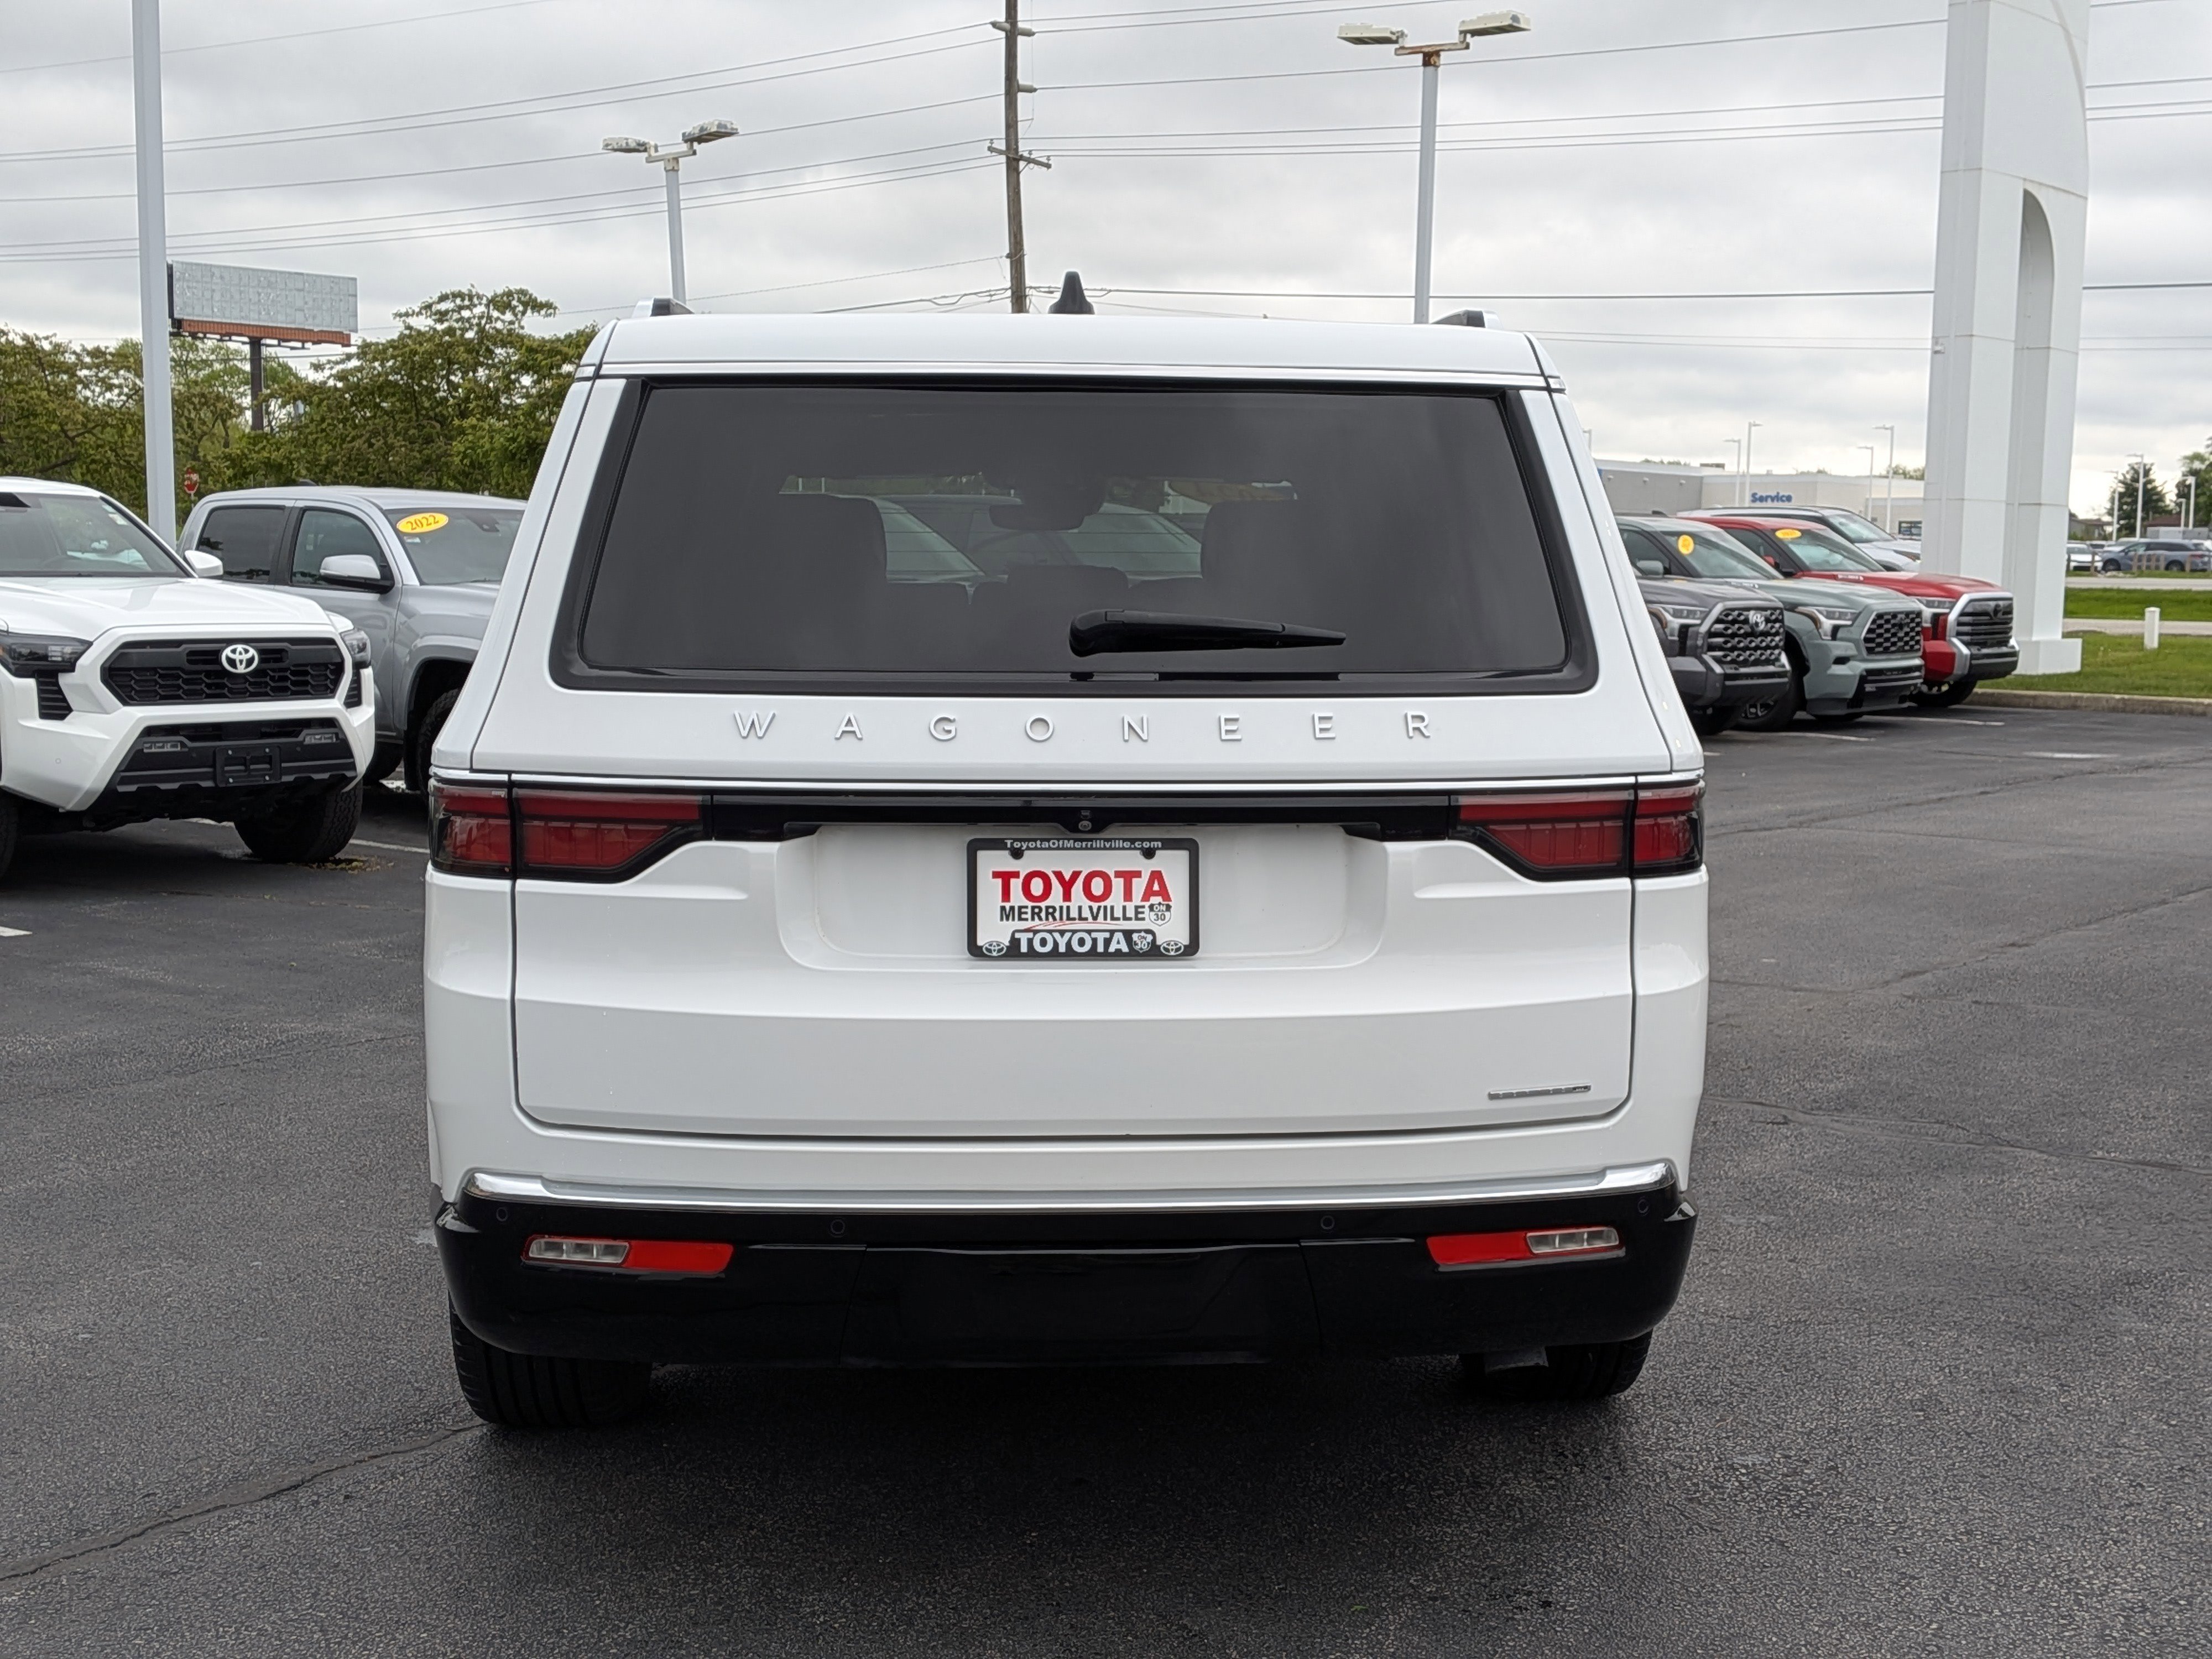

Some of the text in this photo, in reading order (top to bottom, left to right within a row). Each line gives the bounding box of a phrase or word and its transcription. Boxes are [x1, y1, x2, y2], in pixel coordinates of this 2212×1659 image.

[1751, 492, 1792, 503] Service
[406, 514, 439, 531] 2022
[734, 711, 1431, 740] WAGONEER
[1004, 839, 1161, 849] ToyotaOfMerrillville.com
[992, 870, 1172, 902] TOYOTA
[999, 905, 1146, 921] MERRILLVILLE
[1154, 913, 1166, 921] 30
[1015, 932, 1130, 953] TOYOTA
